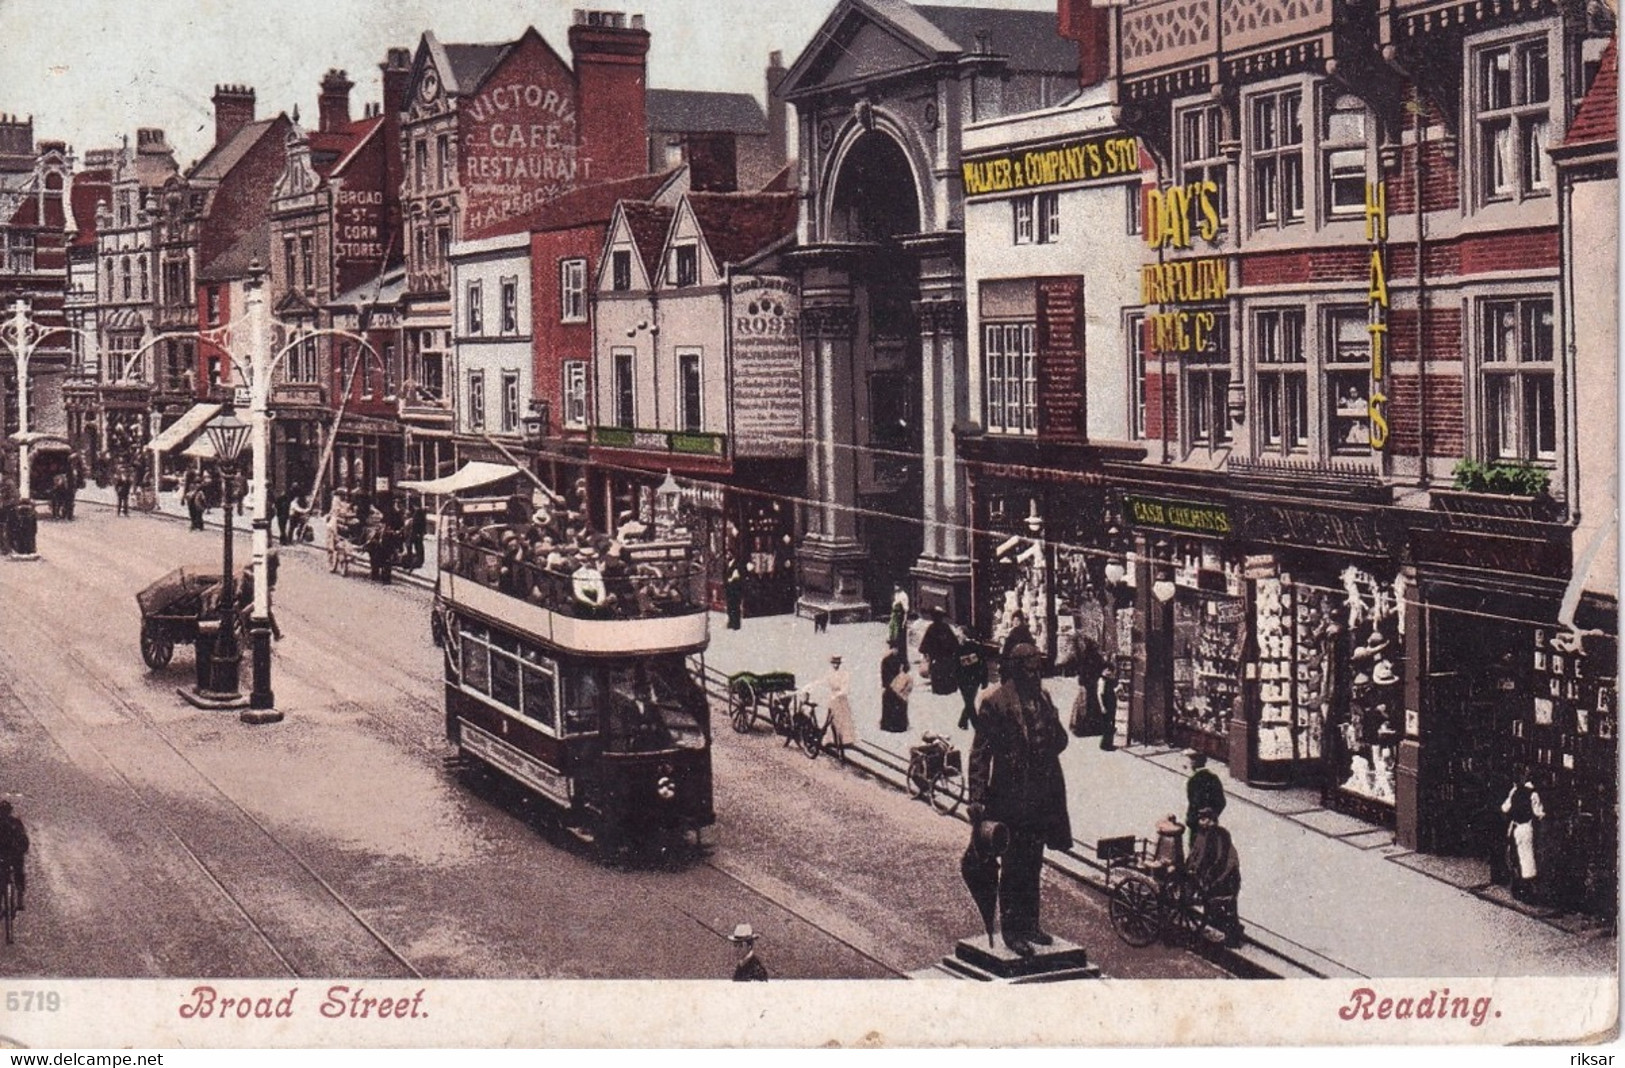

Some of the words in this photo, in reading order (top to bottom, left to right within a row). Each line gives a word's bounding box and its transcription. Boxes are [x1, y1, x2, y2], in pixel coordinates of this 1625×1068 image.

[963, 158, 1013, 194] WALKER
[1014, 161, 1024, 188] &
[1025, 144, 1102, 187] COMPANY'S
[339, 191, 382, 205] BROAD
[1148, 181, 1218, 249] DAY'S
[344, 226, 378, 239] CORN
[338, 243, 383, 257] STORES
[1365, 179, 1388, 449] HATS
[1134, 501, 1165, 524] CASH
